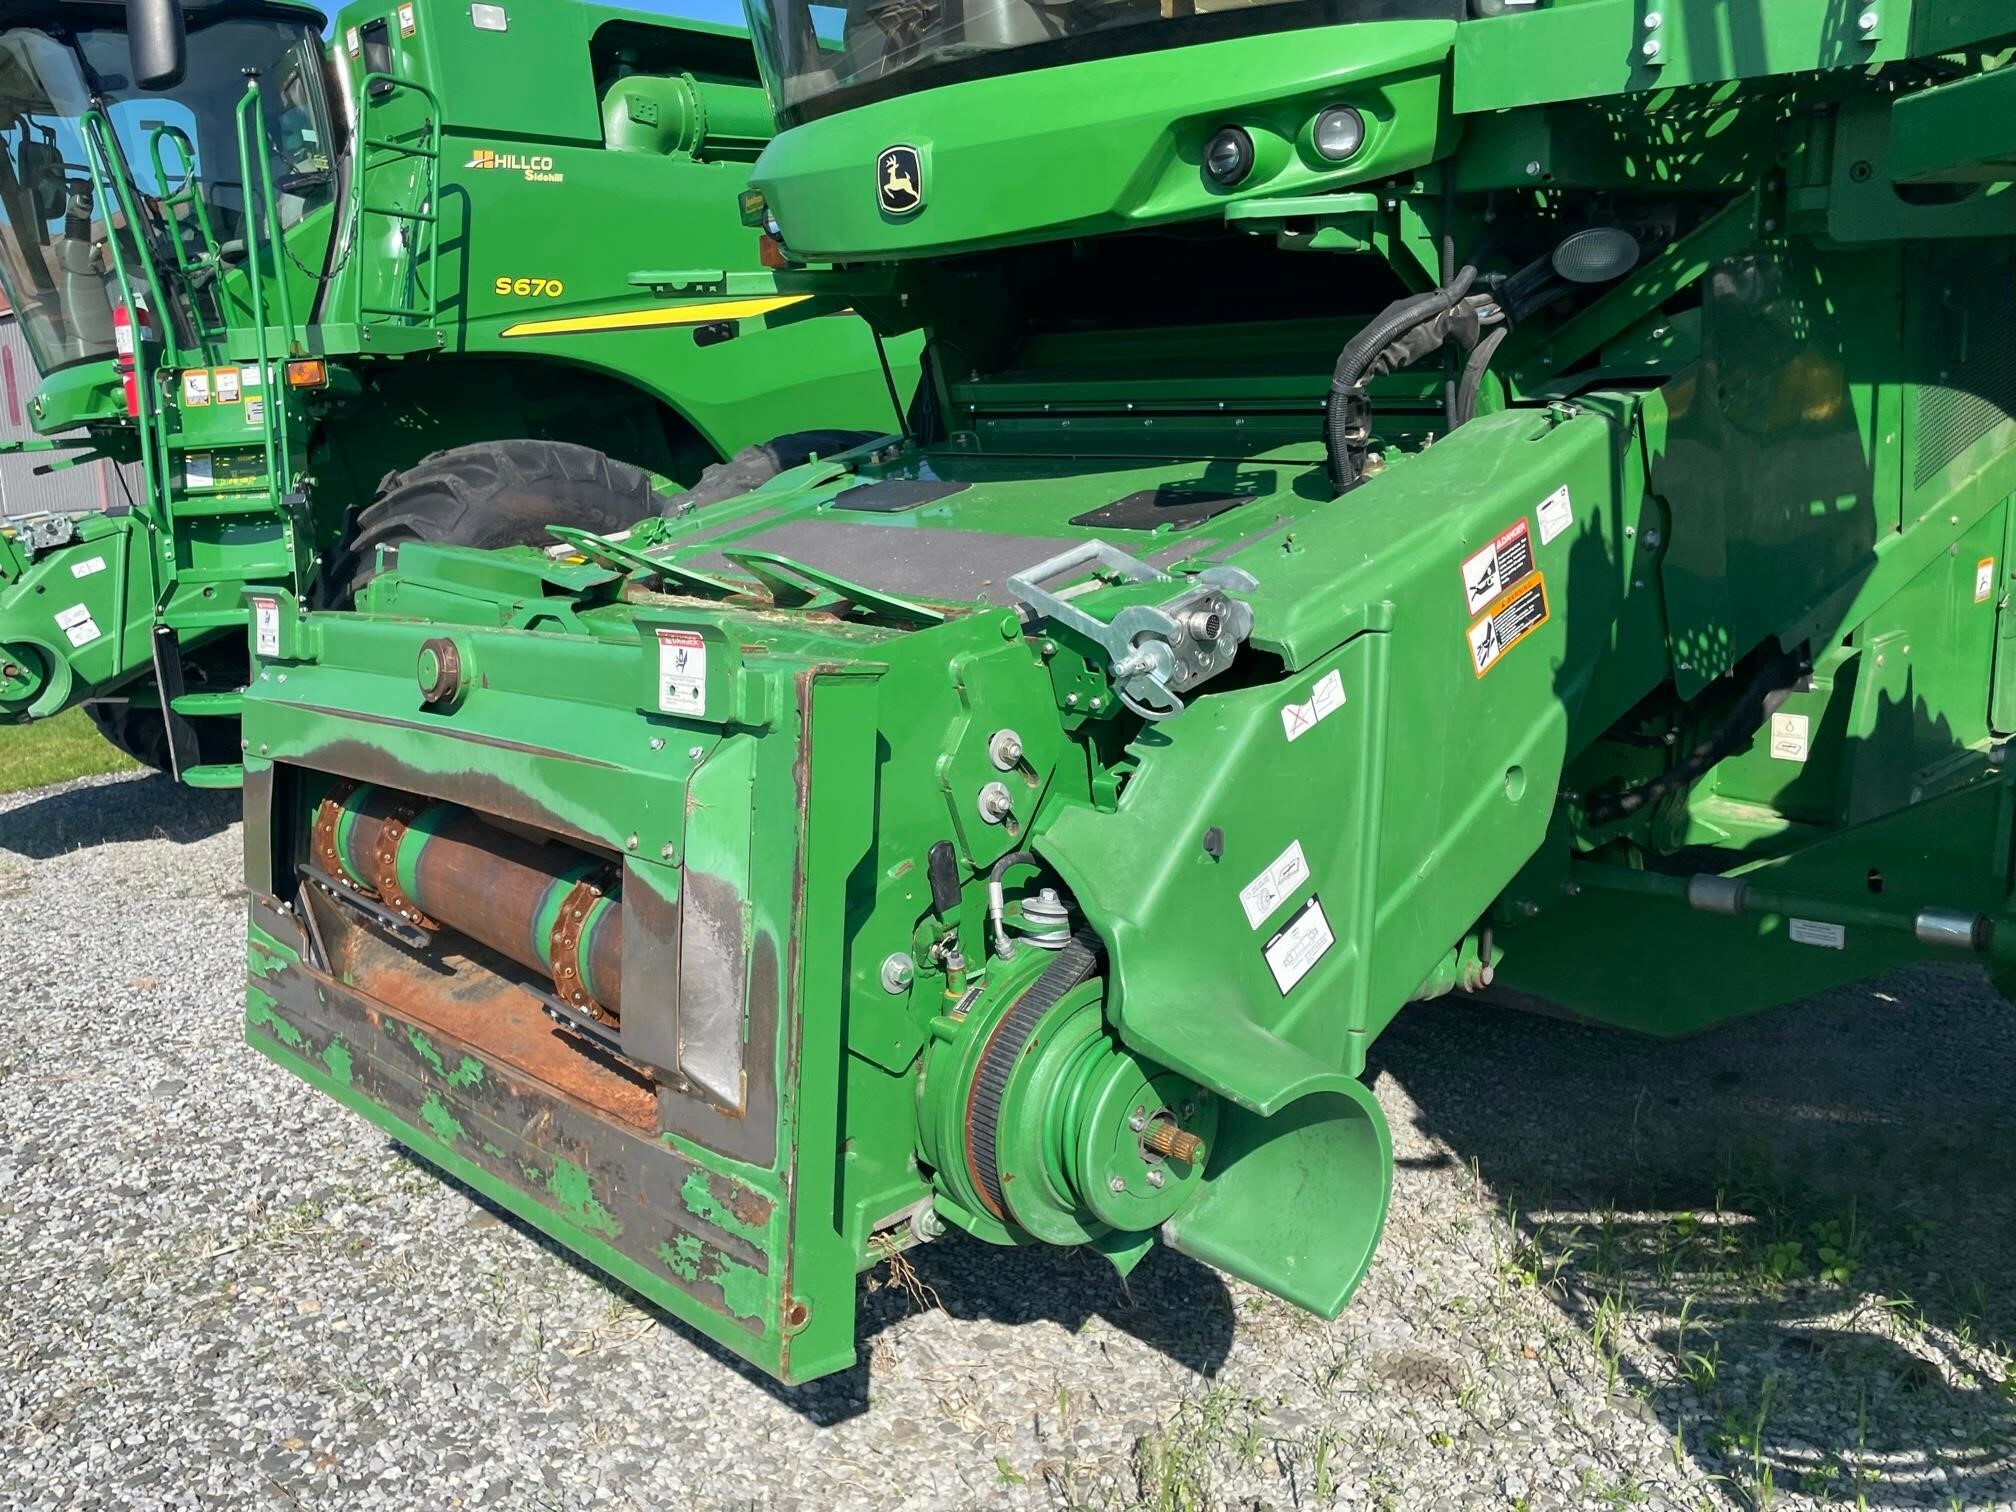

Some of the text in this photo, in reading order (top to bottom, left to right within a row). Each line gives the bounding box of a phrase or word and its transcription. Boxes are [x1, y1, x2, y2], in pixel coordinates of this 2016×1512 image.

[494, 154, 553, 171] HILLCO
[525, 169, 563, 182] Sidehill
[495, 277, 564, 297] S670
[1501, 521, 1527, 546] DANGER
